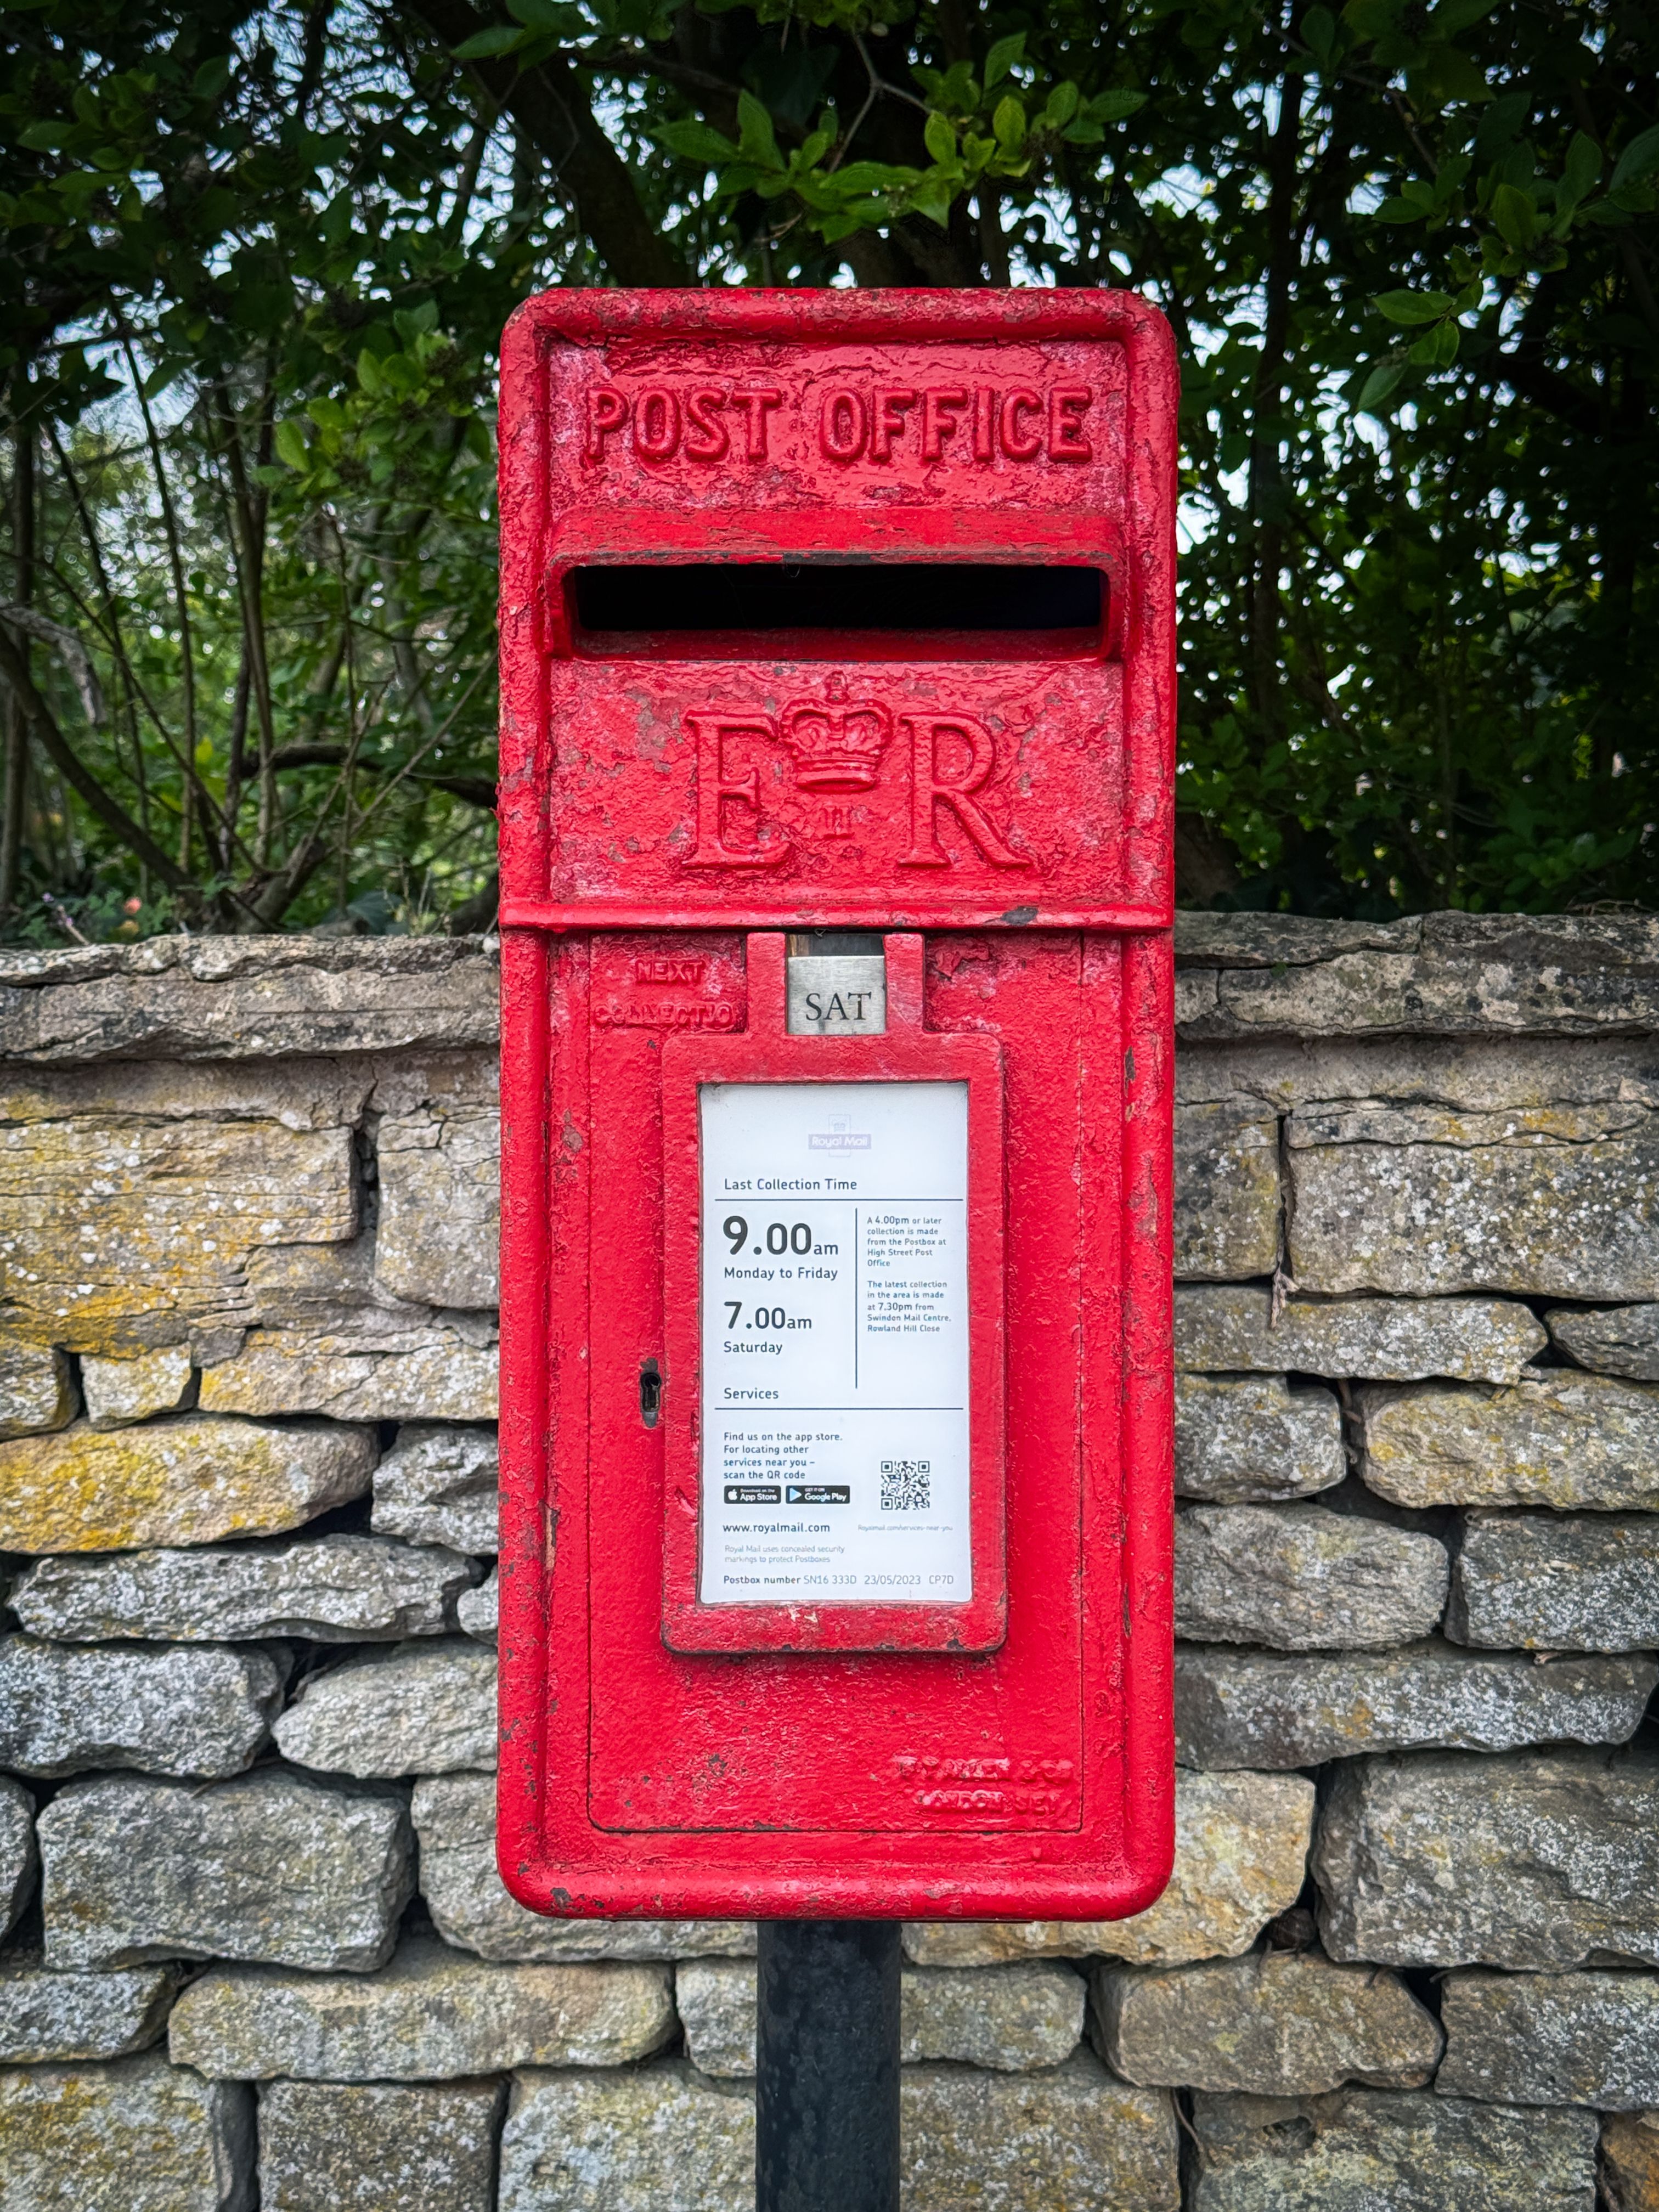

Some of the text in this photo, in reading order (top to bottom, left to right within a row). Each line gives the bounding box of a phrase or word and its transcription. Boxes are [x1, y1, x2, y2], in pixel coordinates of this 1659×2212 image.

[583, 386, 1092, 464] POST OFFICE
[682, 709, 794, 870] E
[896, 709, 1033, 870] R
[636, 961, 704, 984] NEXT
[806, 992, 871, 1020] SAT
[593, 1003, 735, 1029] COLLECTIO
[812, 1136, 868, 1148] Royal Mail
[725, 1178, 857, 1190] Last Collection Time
[875, 1216, 909, 1225] 4.00pm
[723, 1216, 838, 1255] 9.00am
[867, 1248, 885, 1257] High
[725, 1267, 838, 1280] Monday to Friday
[878, 1302, 912, 1312] 7.30pm
[724, 1301, 811, 1329] 7.00am
[724, 1341, 782, 1355] Saturday
[724, 1387, 778, 1399] Services
[724, 1432, 743, 1441] Find
[777, 1432, 792, 1441] the
[795, 1434, 812, 1443] app
[816, 1433, 842, 1441] store.
[724, 1444, 809, 1455] For locating other
[724, 1458, 761, 1466] services
[789, 1459, 806, 1468] you
[748, 1470, 763, 1479] the
[767, 1470, 780, 1480] QR
[784, 1470, 805, 1480] code
[740, 1493, 777, 1502] App Store
[805, 1493, 847, 1503] Google Play
[723, 1522, 830, 1534] www.royalmail.com
[725, 1545, 743, 1554] Royal
[817, 1545, 845, 1554] security
[725, 1555, 757, 1564] markings
[769, 1555, 793, 1564] protect
[795, 1555, 831, 1563] Postboxes
[724, 1575, 954, 1585] Postbox number SN16 333D 23/05/2023 CP7D
